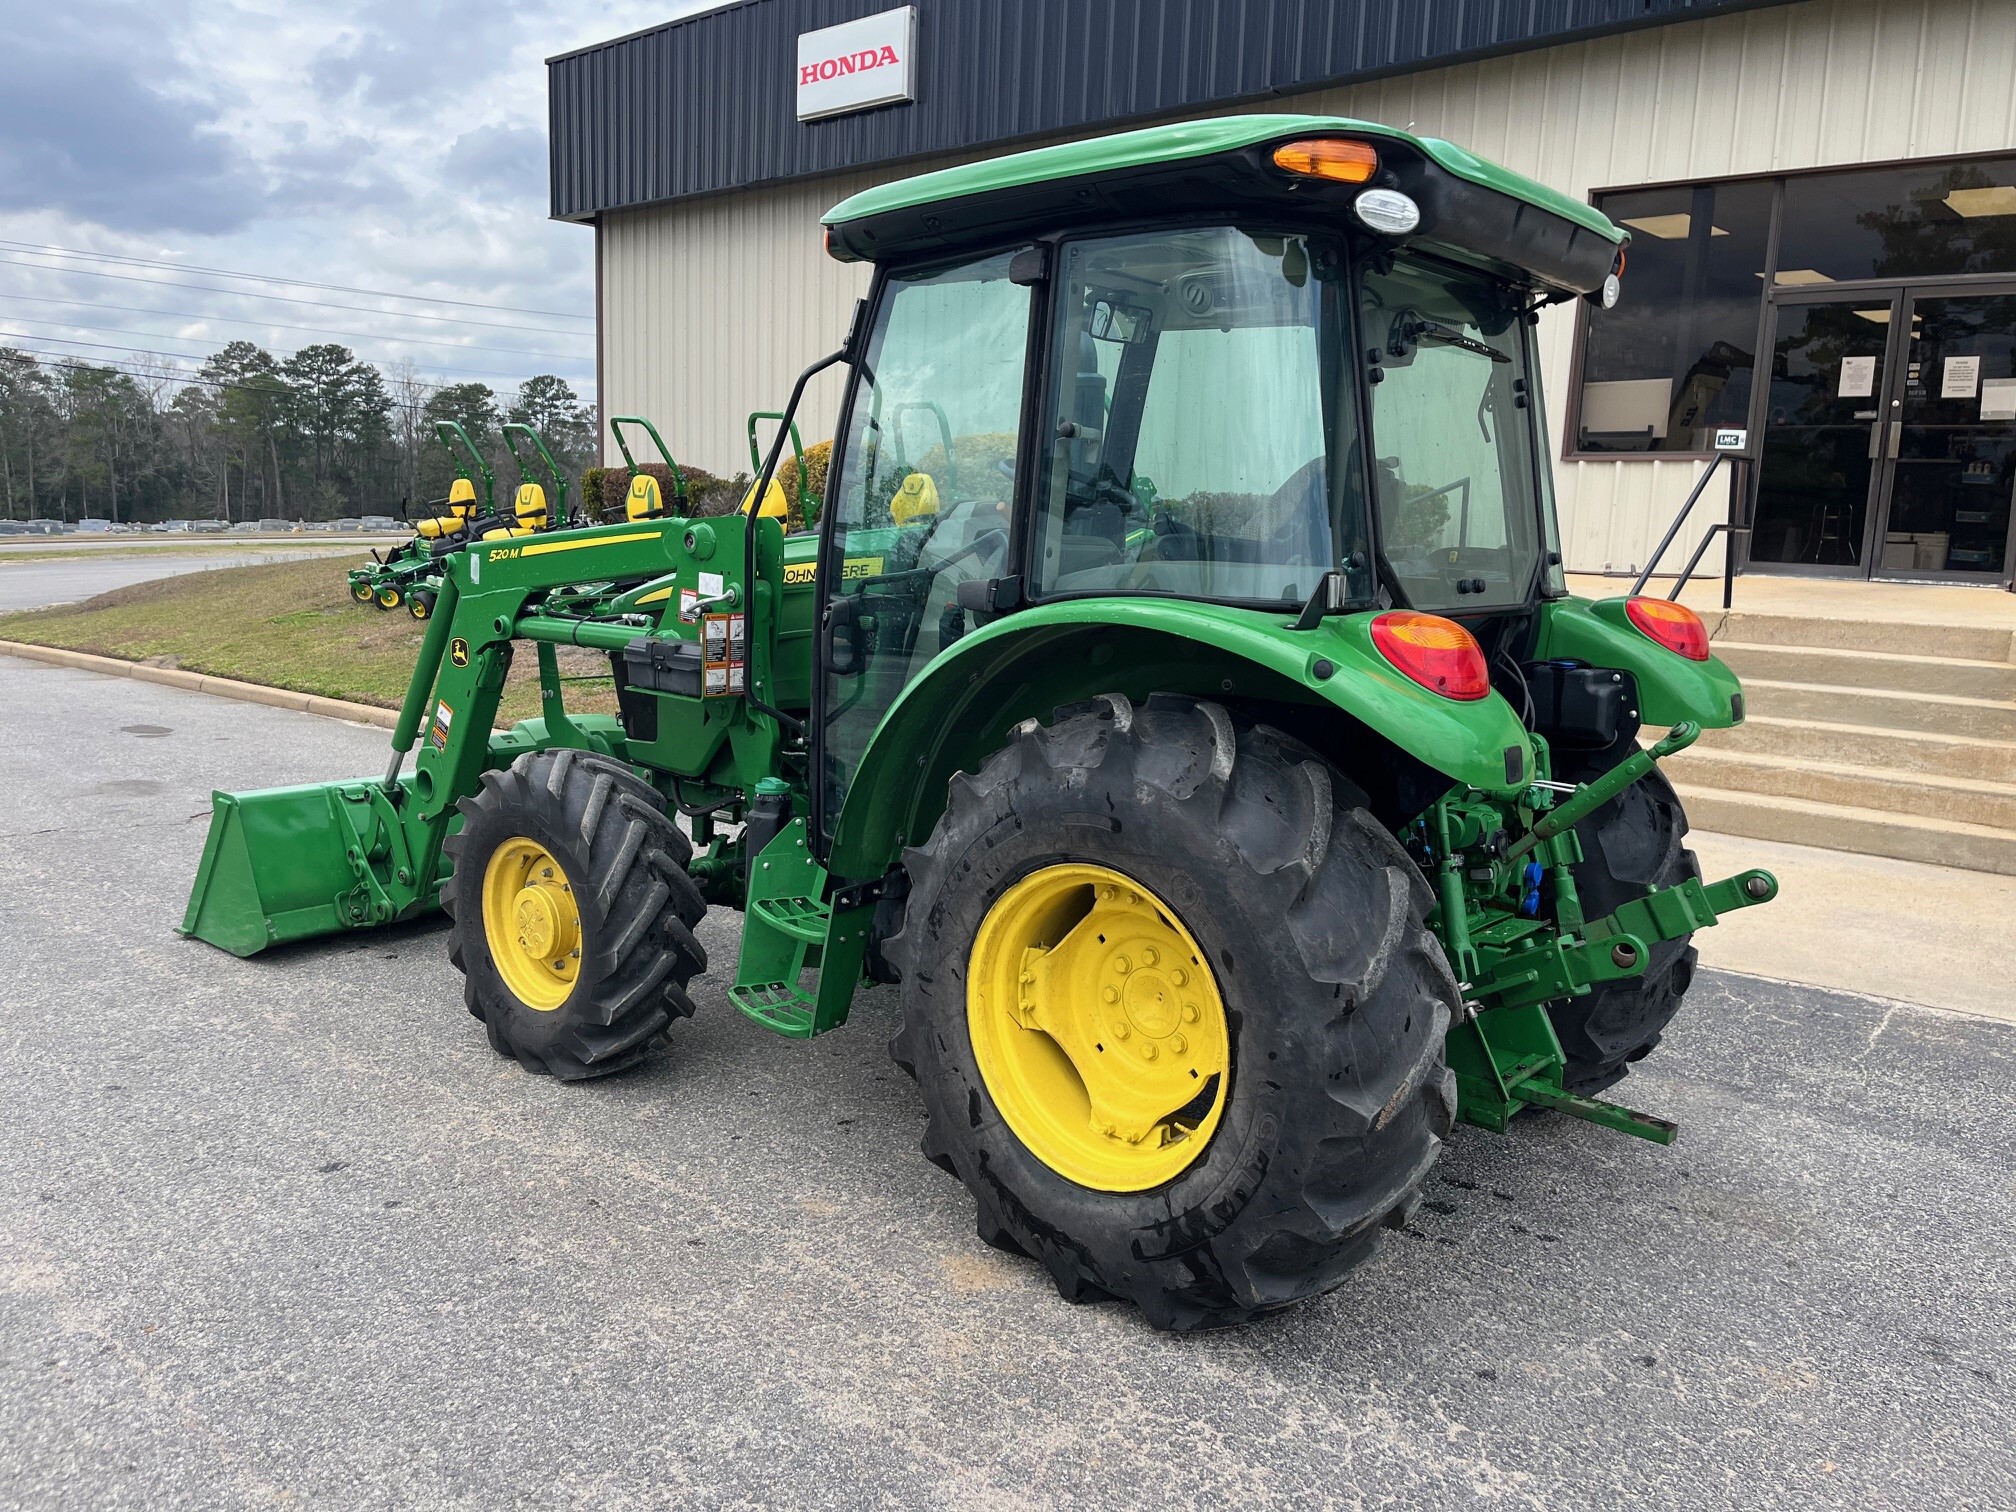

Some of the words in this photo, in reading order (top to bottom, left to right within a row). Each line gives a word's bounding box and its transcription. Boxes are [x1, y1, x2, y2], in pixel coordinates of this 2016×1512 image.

[800, 45, 899, 86] HONDA
[1720, 435, 1737, 443] LMC
[842, 564, 870, 578] ERE
